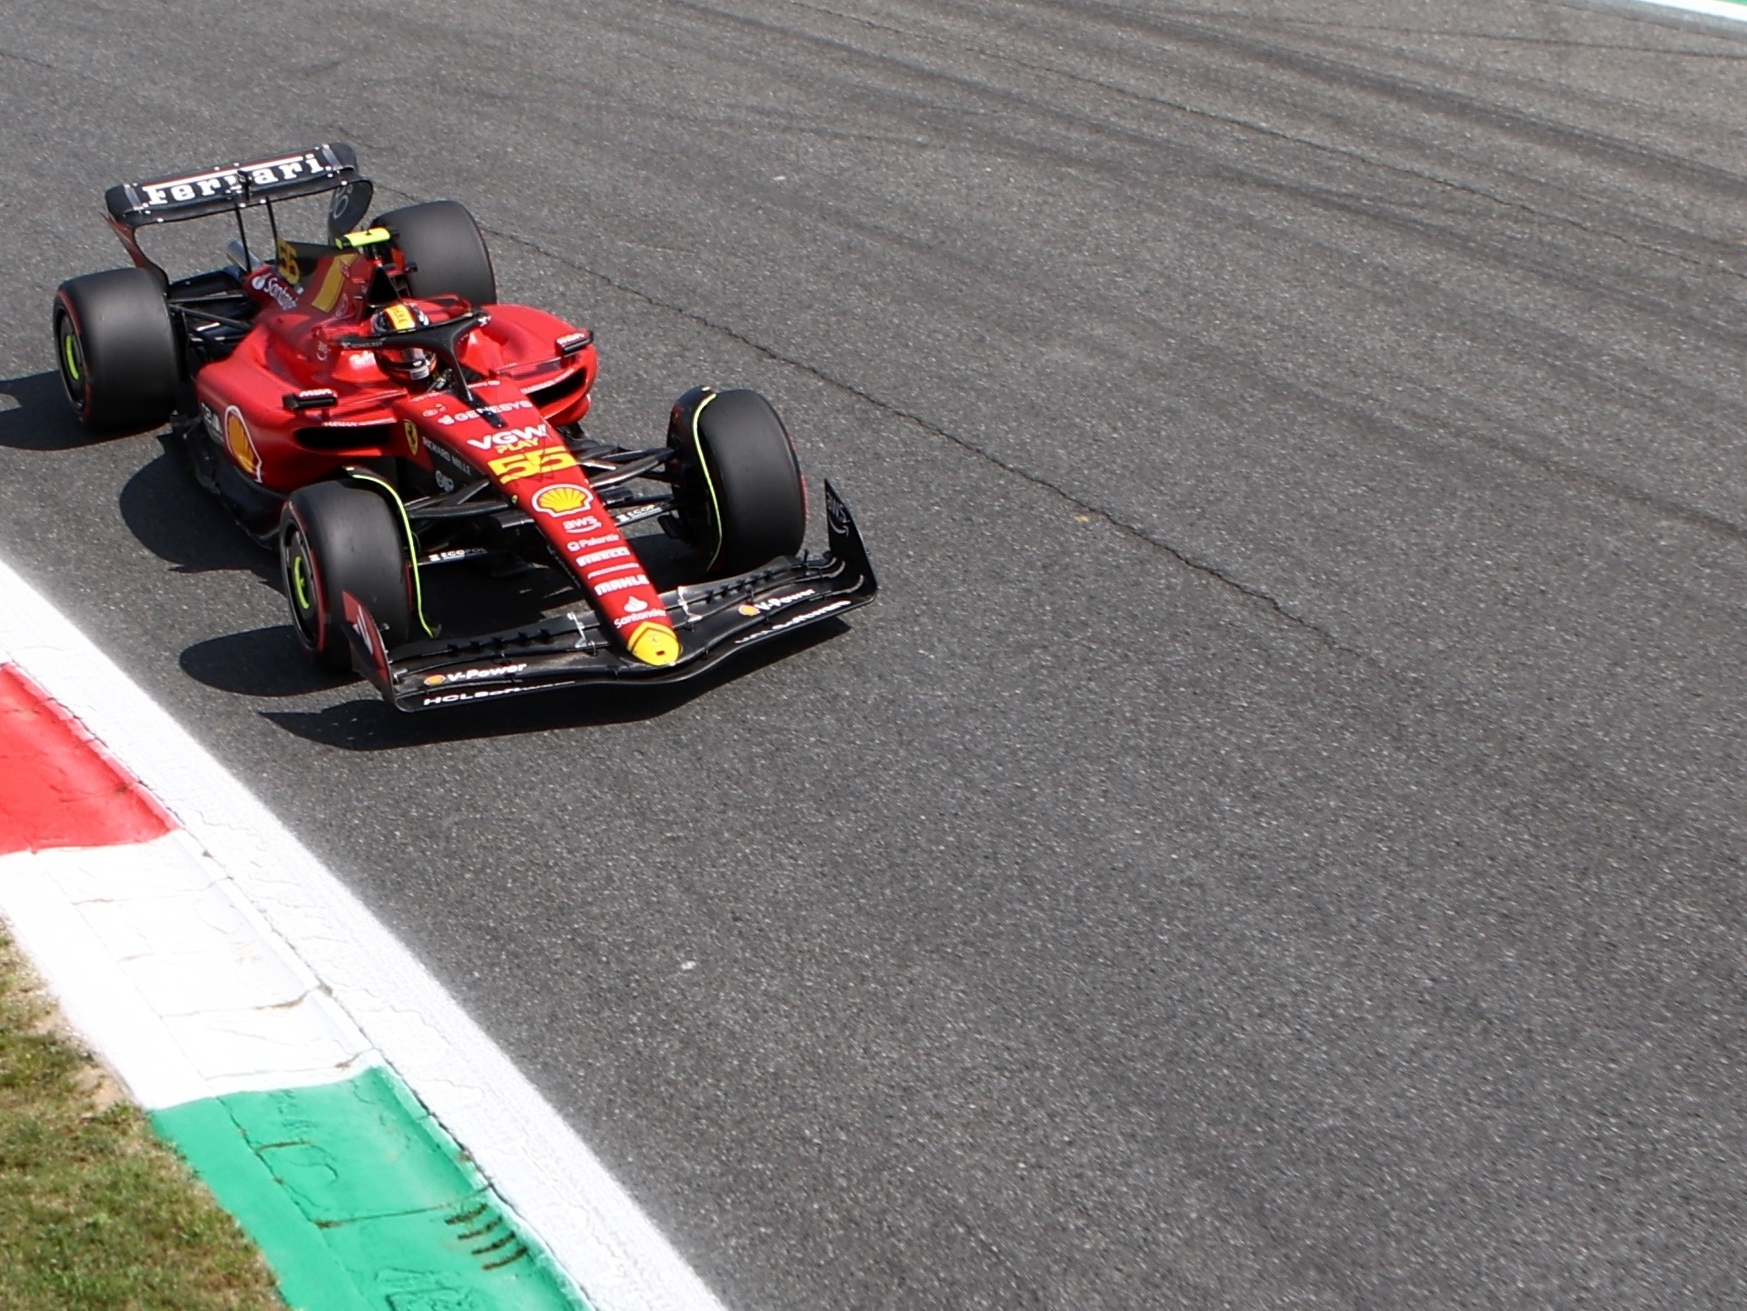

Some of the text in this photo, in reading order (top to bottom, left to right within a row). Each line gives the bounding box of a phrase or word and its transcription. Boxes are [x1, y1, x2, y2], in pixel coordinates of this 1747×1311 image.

[495, 437, 540, 454] PLAY
[487, 445, 578, 485] 55
[447, 663, 528, 681] V-Power
